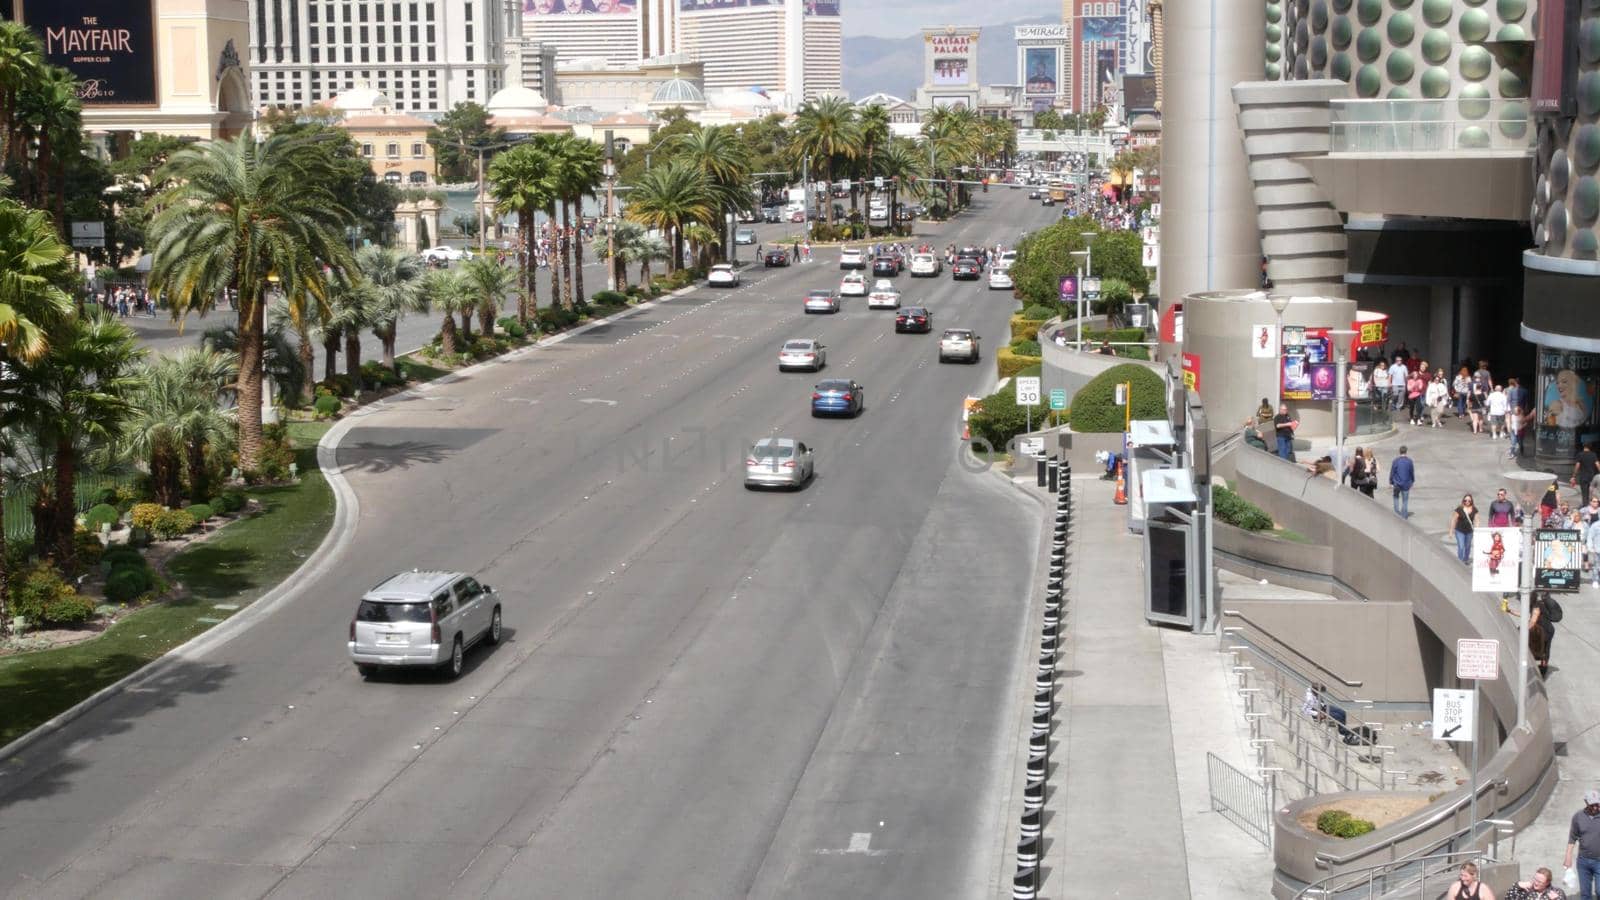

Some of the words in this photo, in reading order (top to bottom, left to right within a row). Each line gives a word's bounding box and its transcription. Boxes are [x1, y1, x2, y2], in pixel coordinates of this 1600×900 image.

[83, 17, 97, 25] THE
[1025, 26, 1064, 36] MIRAGE
[47, 26, 133, 54] MAYFAIR
[932, 37, 970, 45] CAESARS
[1020, 393, 1037, 402] 30
[1446, 700, 1461, 708] BUS
[1444, 708, 1462, 717] STOP
[1443, 716, 1462, 725] ONLY
